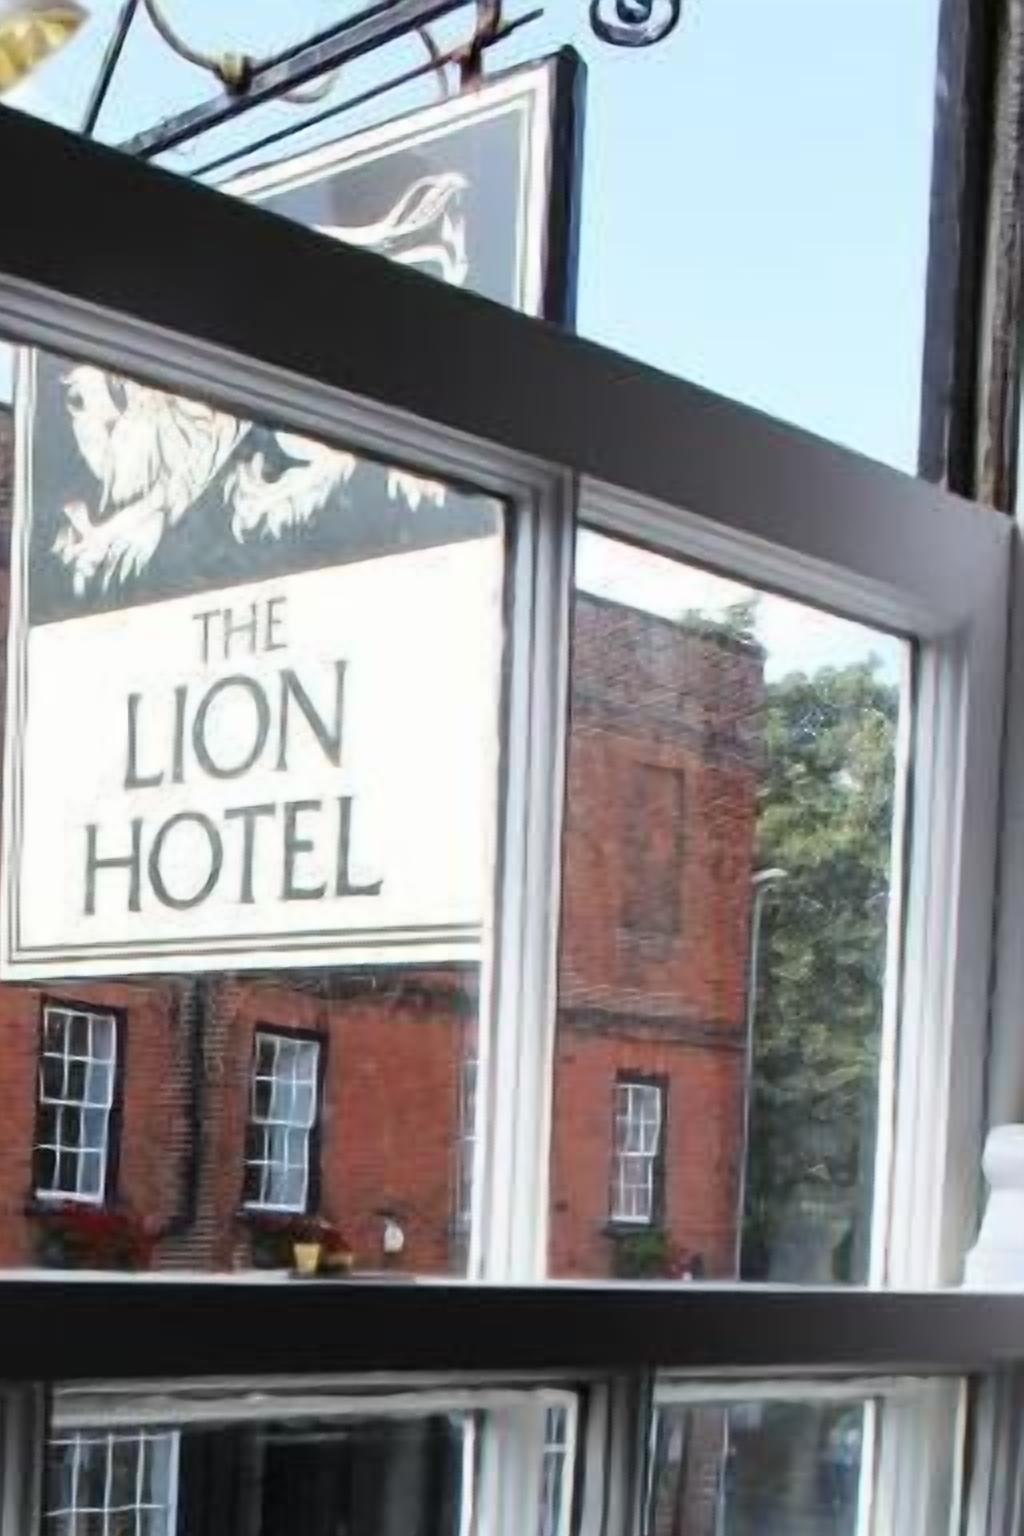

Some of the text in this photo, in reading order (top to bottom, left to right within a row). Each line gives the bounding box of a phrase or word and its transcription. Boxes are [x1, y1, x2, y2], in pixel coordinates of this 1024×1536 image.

[192, 596, 288, 664] THE
[123, 660, 349, 790] LION
[83, 796, 384, 915] HOTEL
